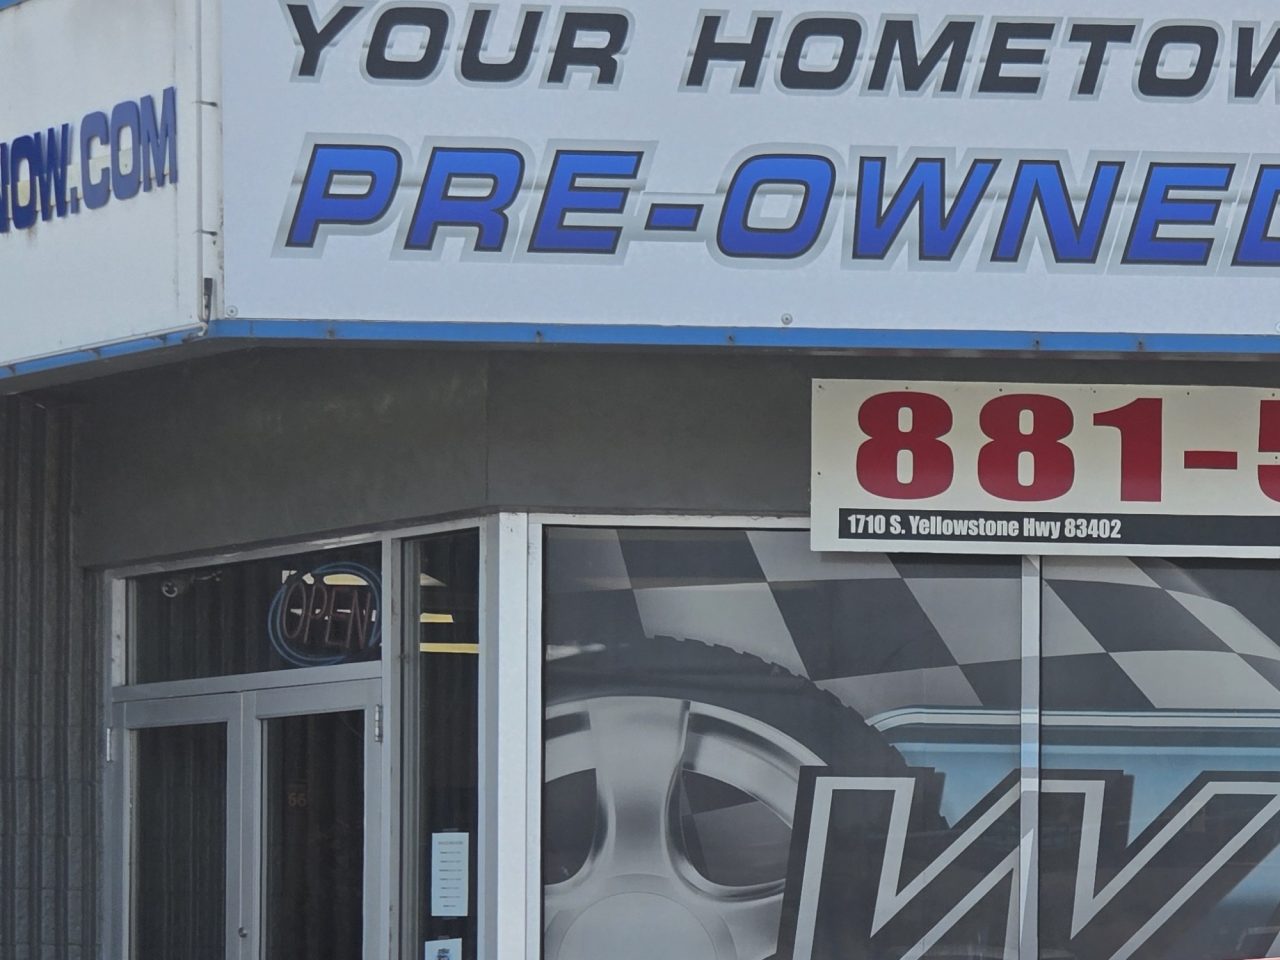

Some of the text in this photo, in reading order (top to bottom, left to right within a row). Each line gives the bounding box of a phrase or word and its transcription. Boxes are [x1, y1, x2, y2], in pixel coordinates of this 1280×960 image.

[286, 3, 632, 86] YOUR
[848, 514, 1122, 539] 1710 S. Yellowstone Hwy 83402
[282, 581, 372, 650] OPEN
